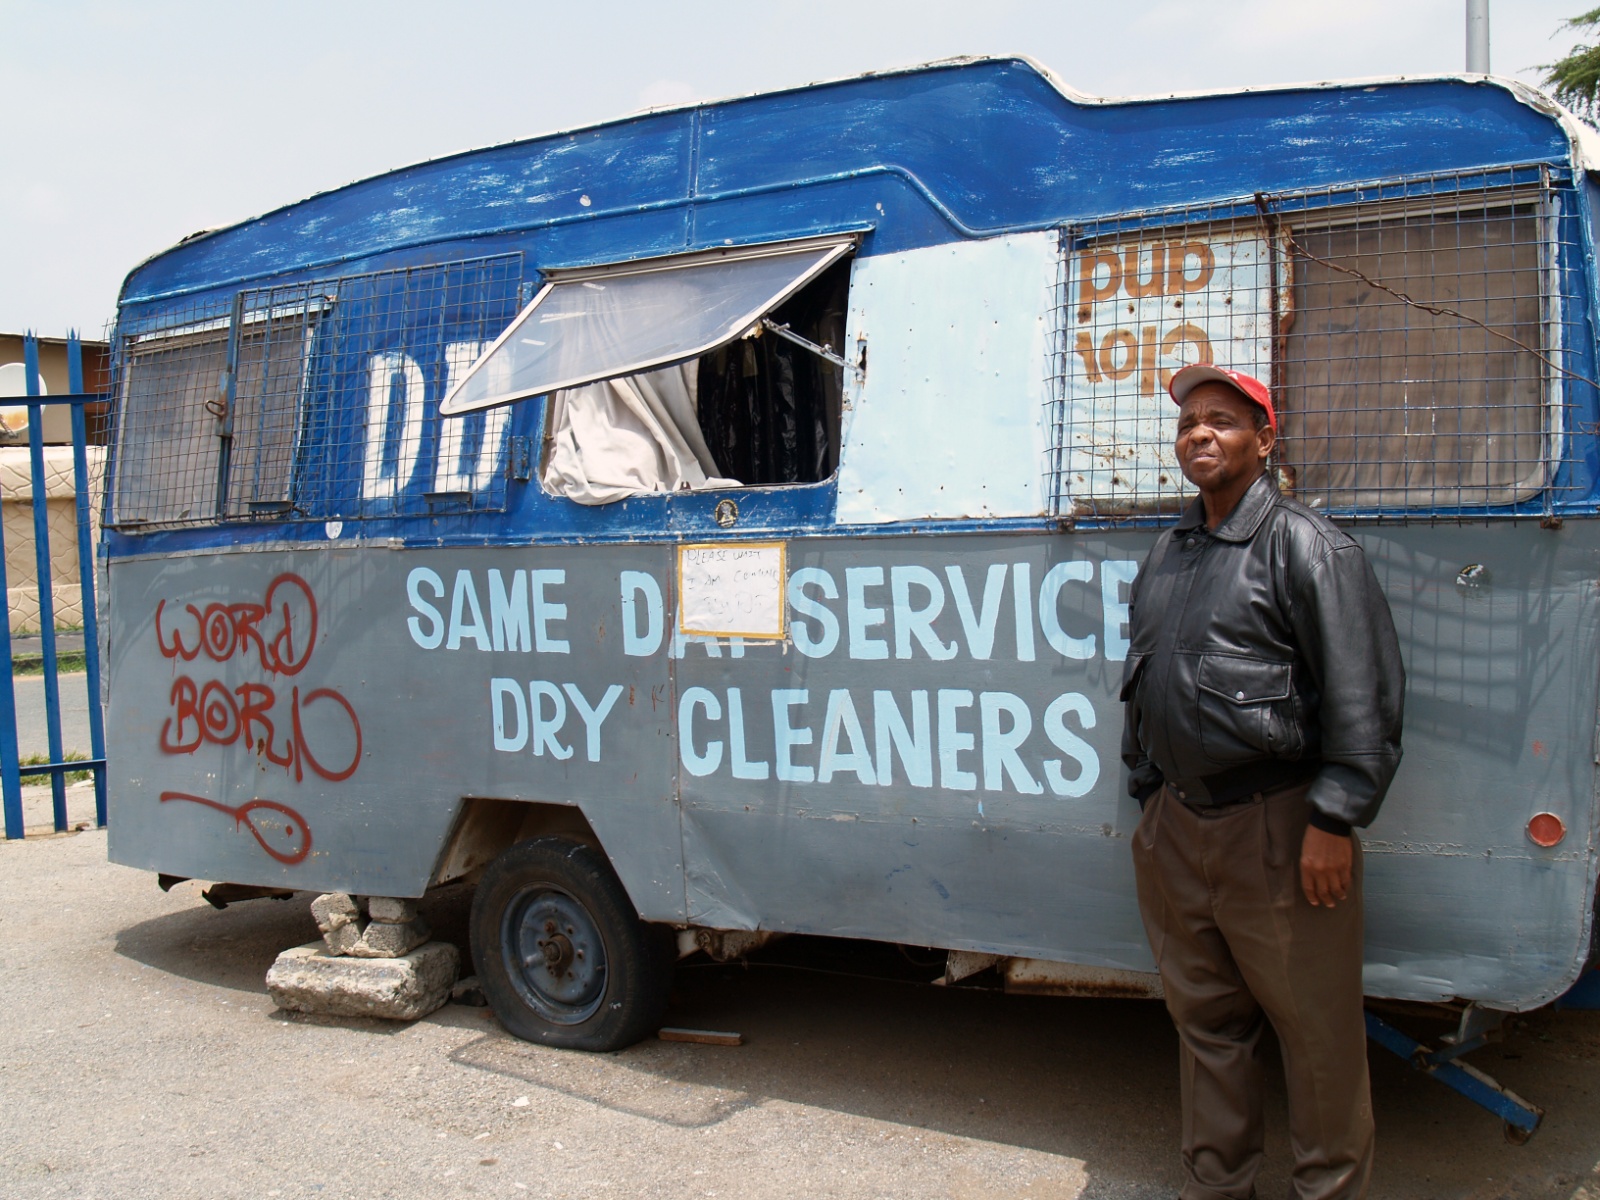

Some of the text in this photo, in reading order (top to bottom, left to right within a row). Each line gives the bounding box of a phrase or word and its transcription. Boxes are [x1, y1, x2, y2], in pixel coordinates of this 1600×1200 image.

[406, 566, 571, 654] SAME
[788, 560, 1138, 662] SERVICE
[490, 677, 1101, 798] DRY CLEANERS
